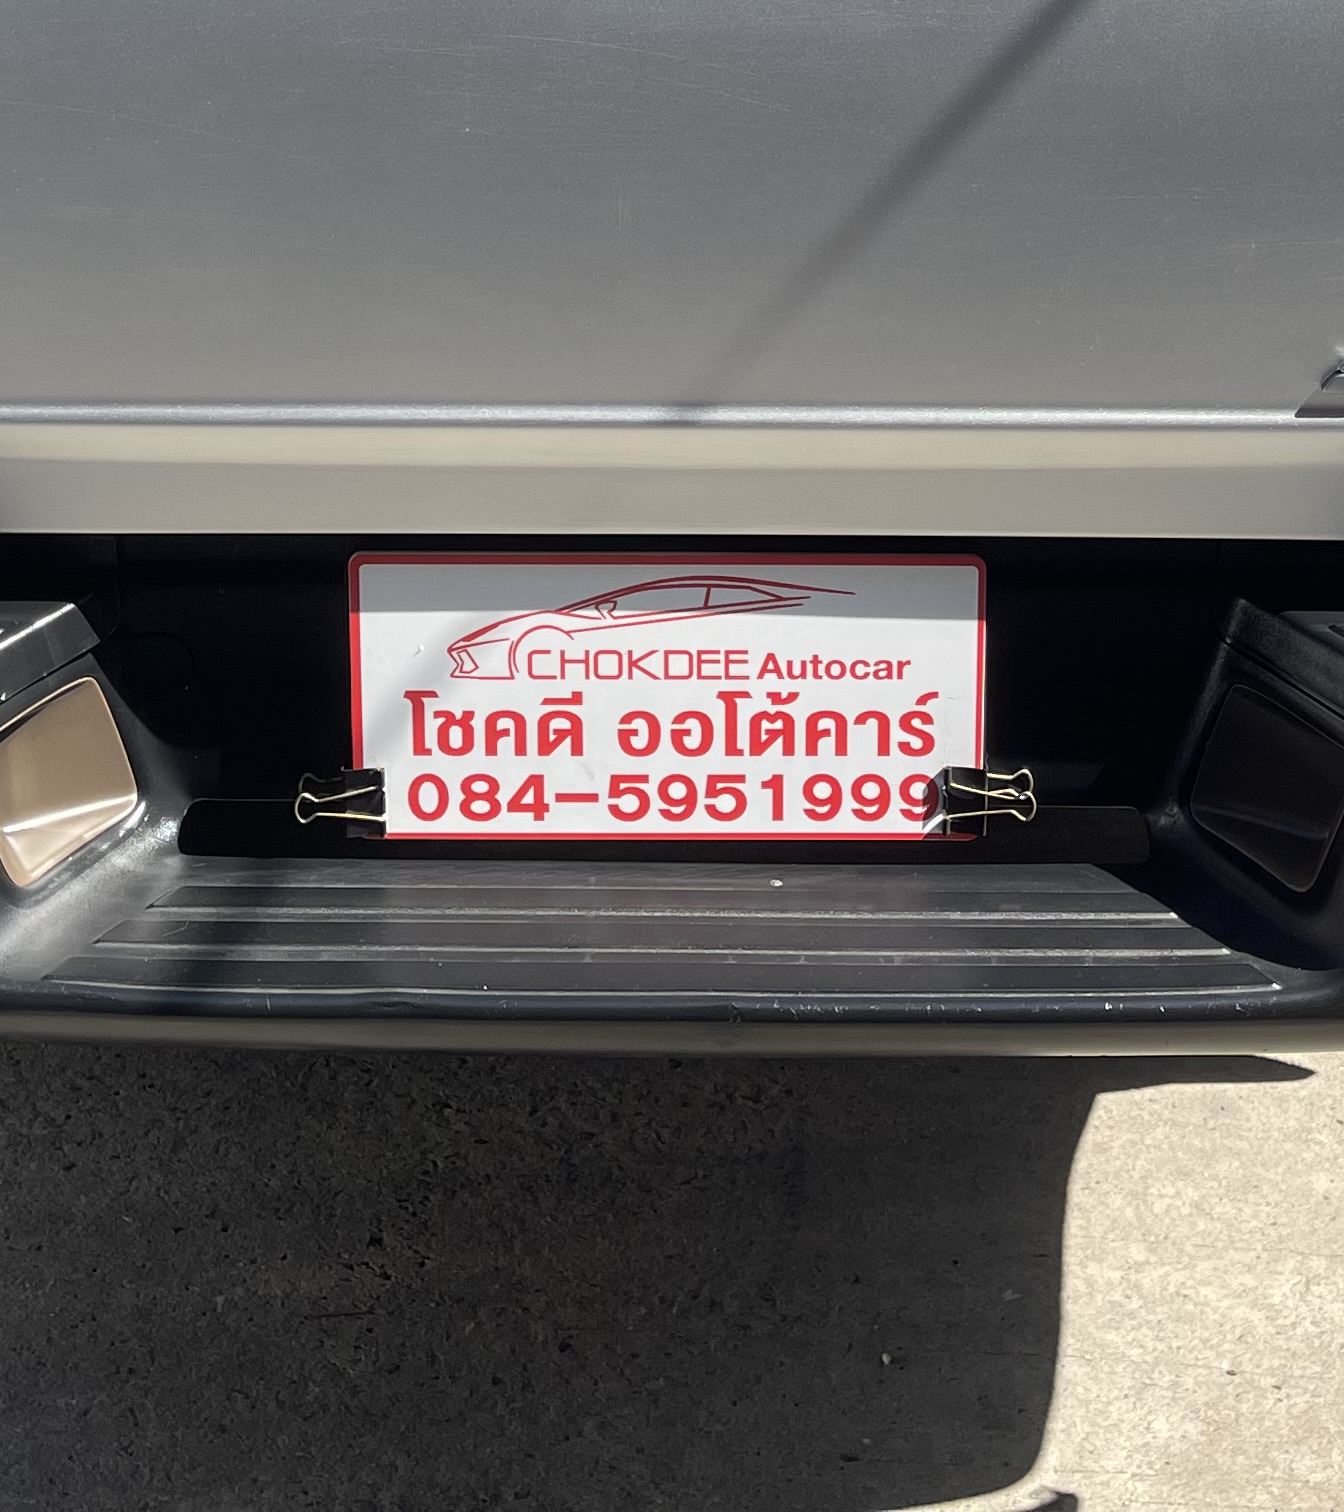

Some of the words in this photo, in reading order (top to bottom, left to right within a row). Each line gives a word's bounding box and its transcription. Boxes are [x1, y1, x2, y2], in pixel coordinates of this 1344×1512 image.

[527, 649, 749, 681] CHOKDEE
[757, 652, 912, 681] Autocar
[404, 690, 584, 757] โชคดี
[617, 690, 940, 758] ออโต้คาร์
[407, 773, 940, 823] 084-5951999
